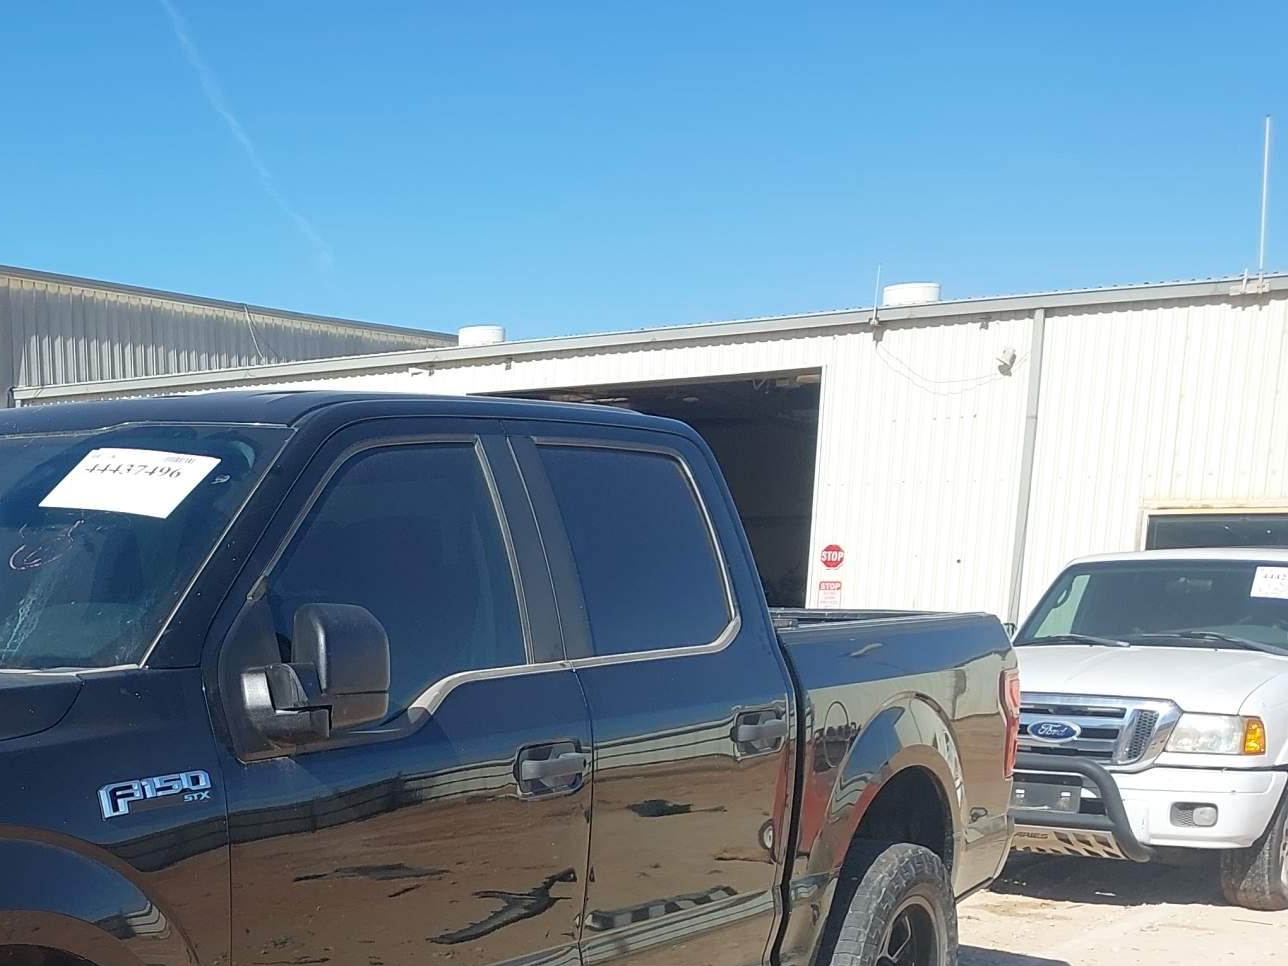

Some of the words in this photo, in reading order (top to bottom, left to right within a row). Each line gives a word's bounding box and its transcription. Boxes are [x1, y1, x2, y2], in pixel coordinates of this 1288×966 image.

[85, 464, 182, 478] 44437496
[821, 550, 844, 562] STOP
[820, 582, 841, 591] STOP
[183, 790, 211, 802] STX
